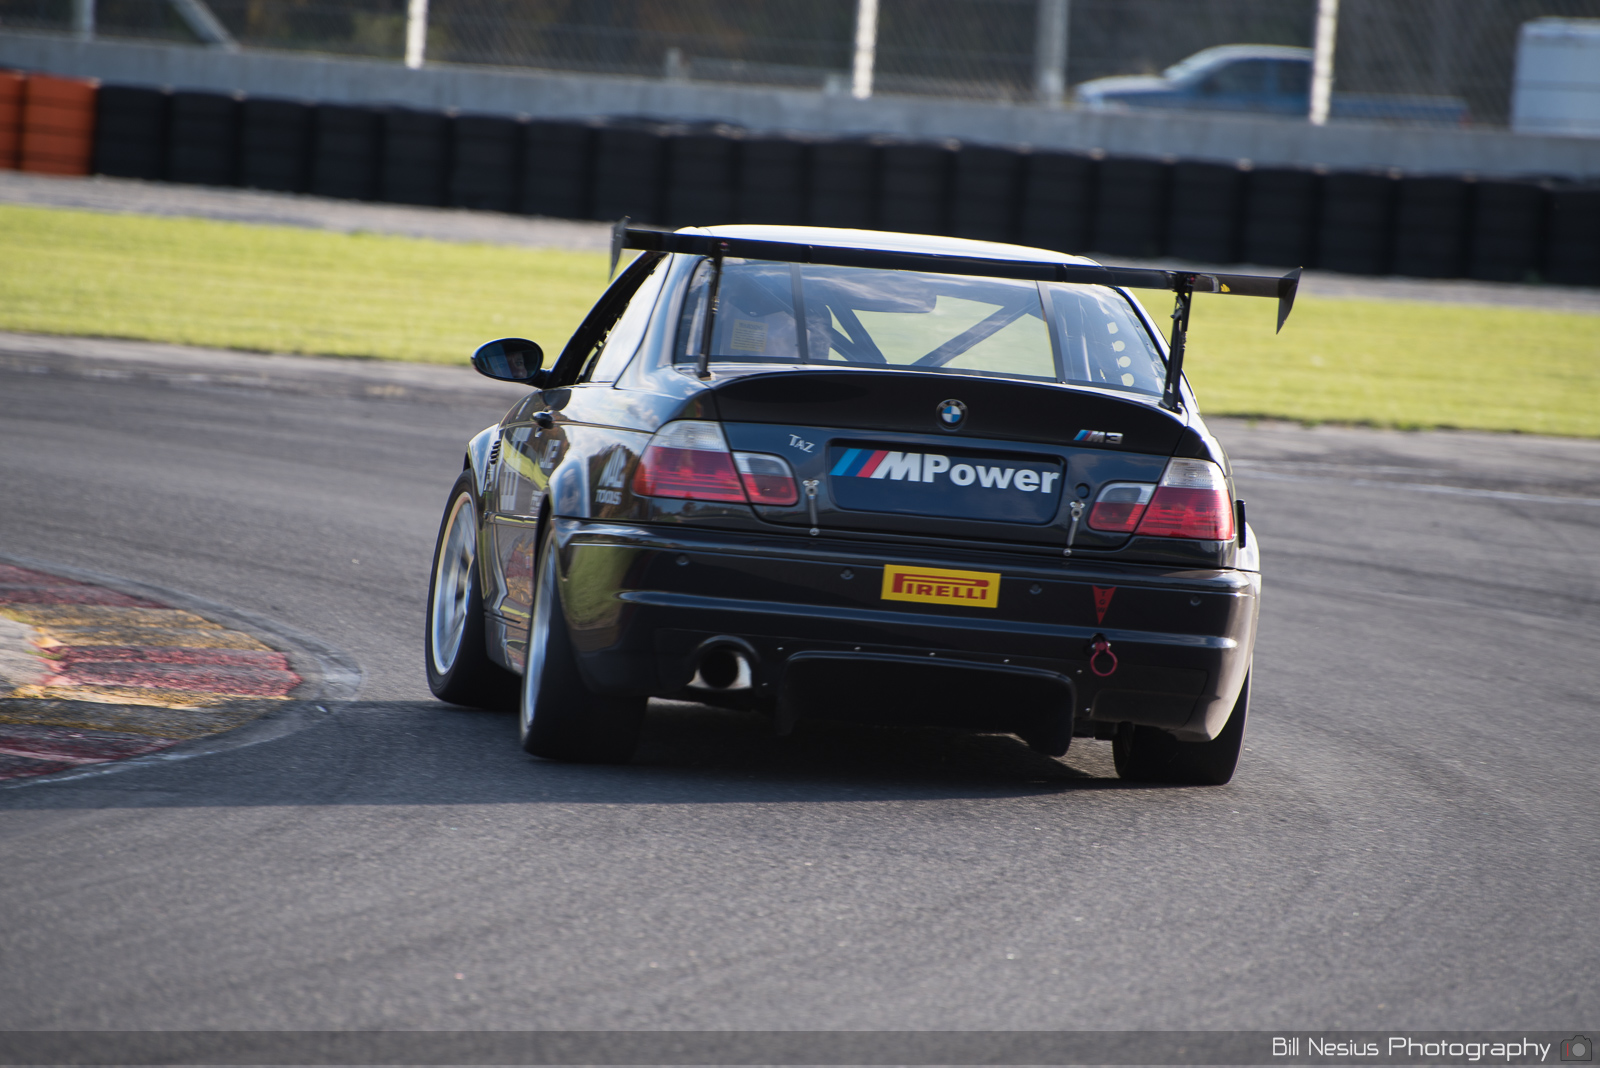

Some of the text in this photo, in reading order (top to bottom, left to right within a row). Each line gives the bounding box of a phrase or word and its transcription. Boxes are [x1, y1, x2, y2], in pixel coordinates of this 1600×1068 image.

[1086, 430, 1123, 444] M3
[870, 451, 1060, 494] MPower
[892, 572, 990, 600] PIRELLI
